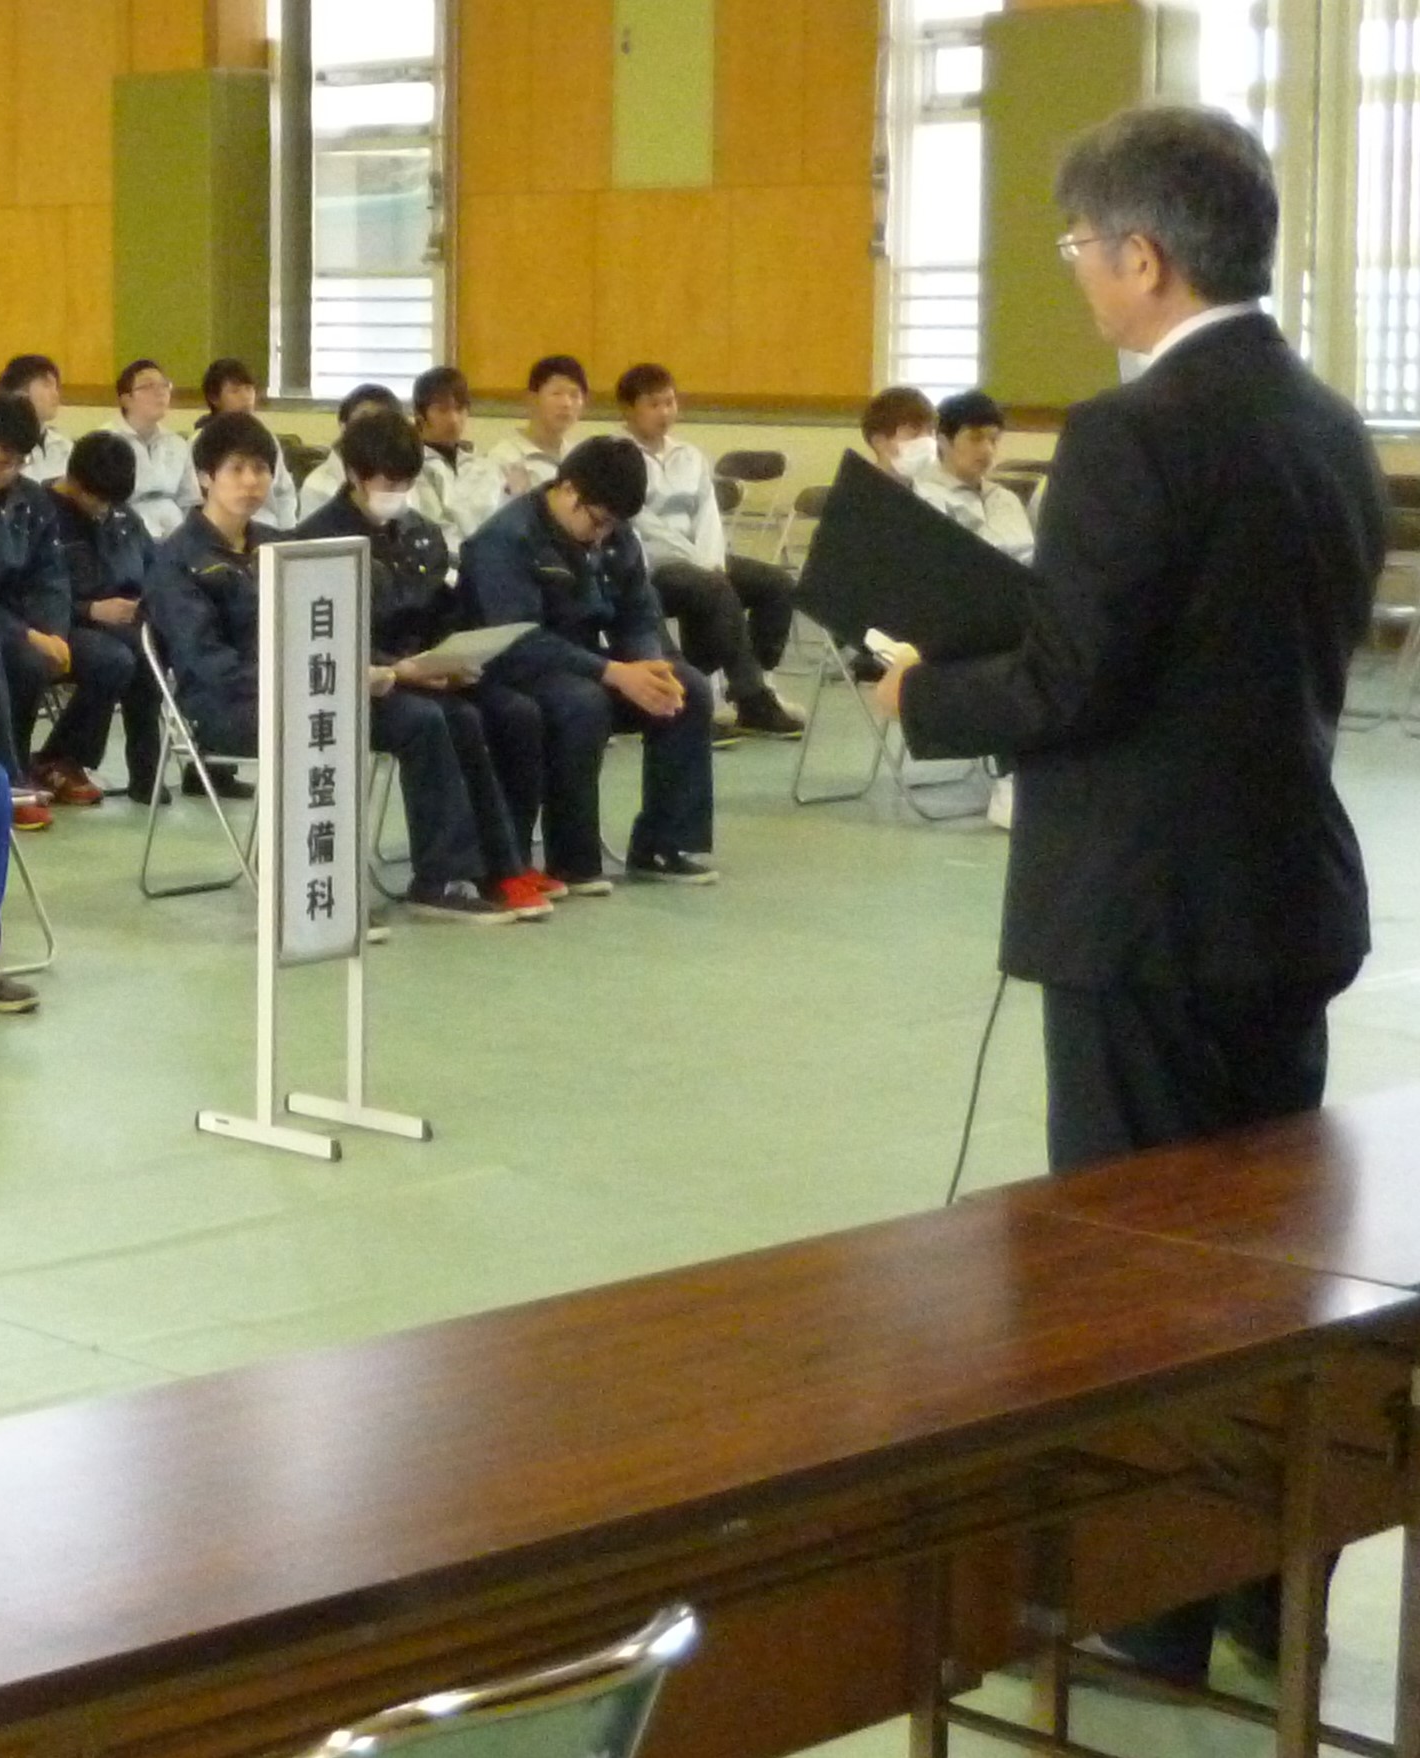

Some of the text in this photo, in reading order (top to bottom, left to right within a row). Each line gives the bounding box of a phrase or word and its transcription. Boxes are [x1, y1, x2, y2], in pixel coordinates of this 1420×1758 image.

[307, 596, 337, 920] 自動車整備科
